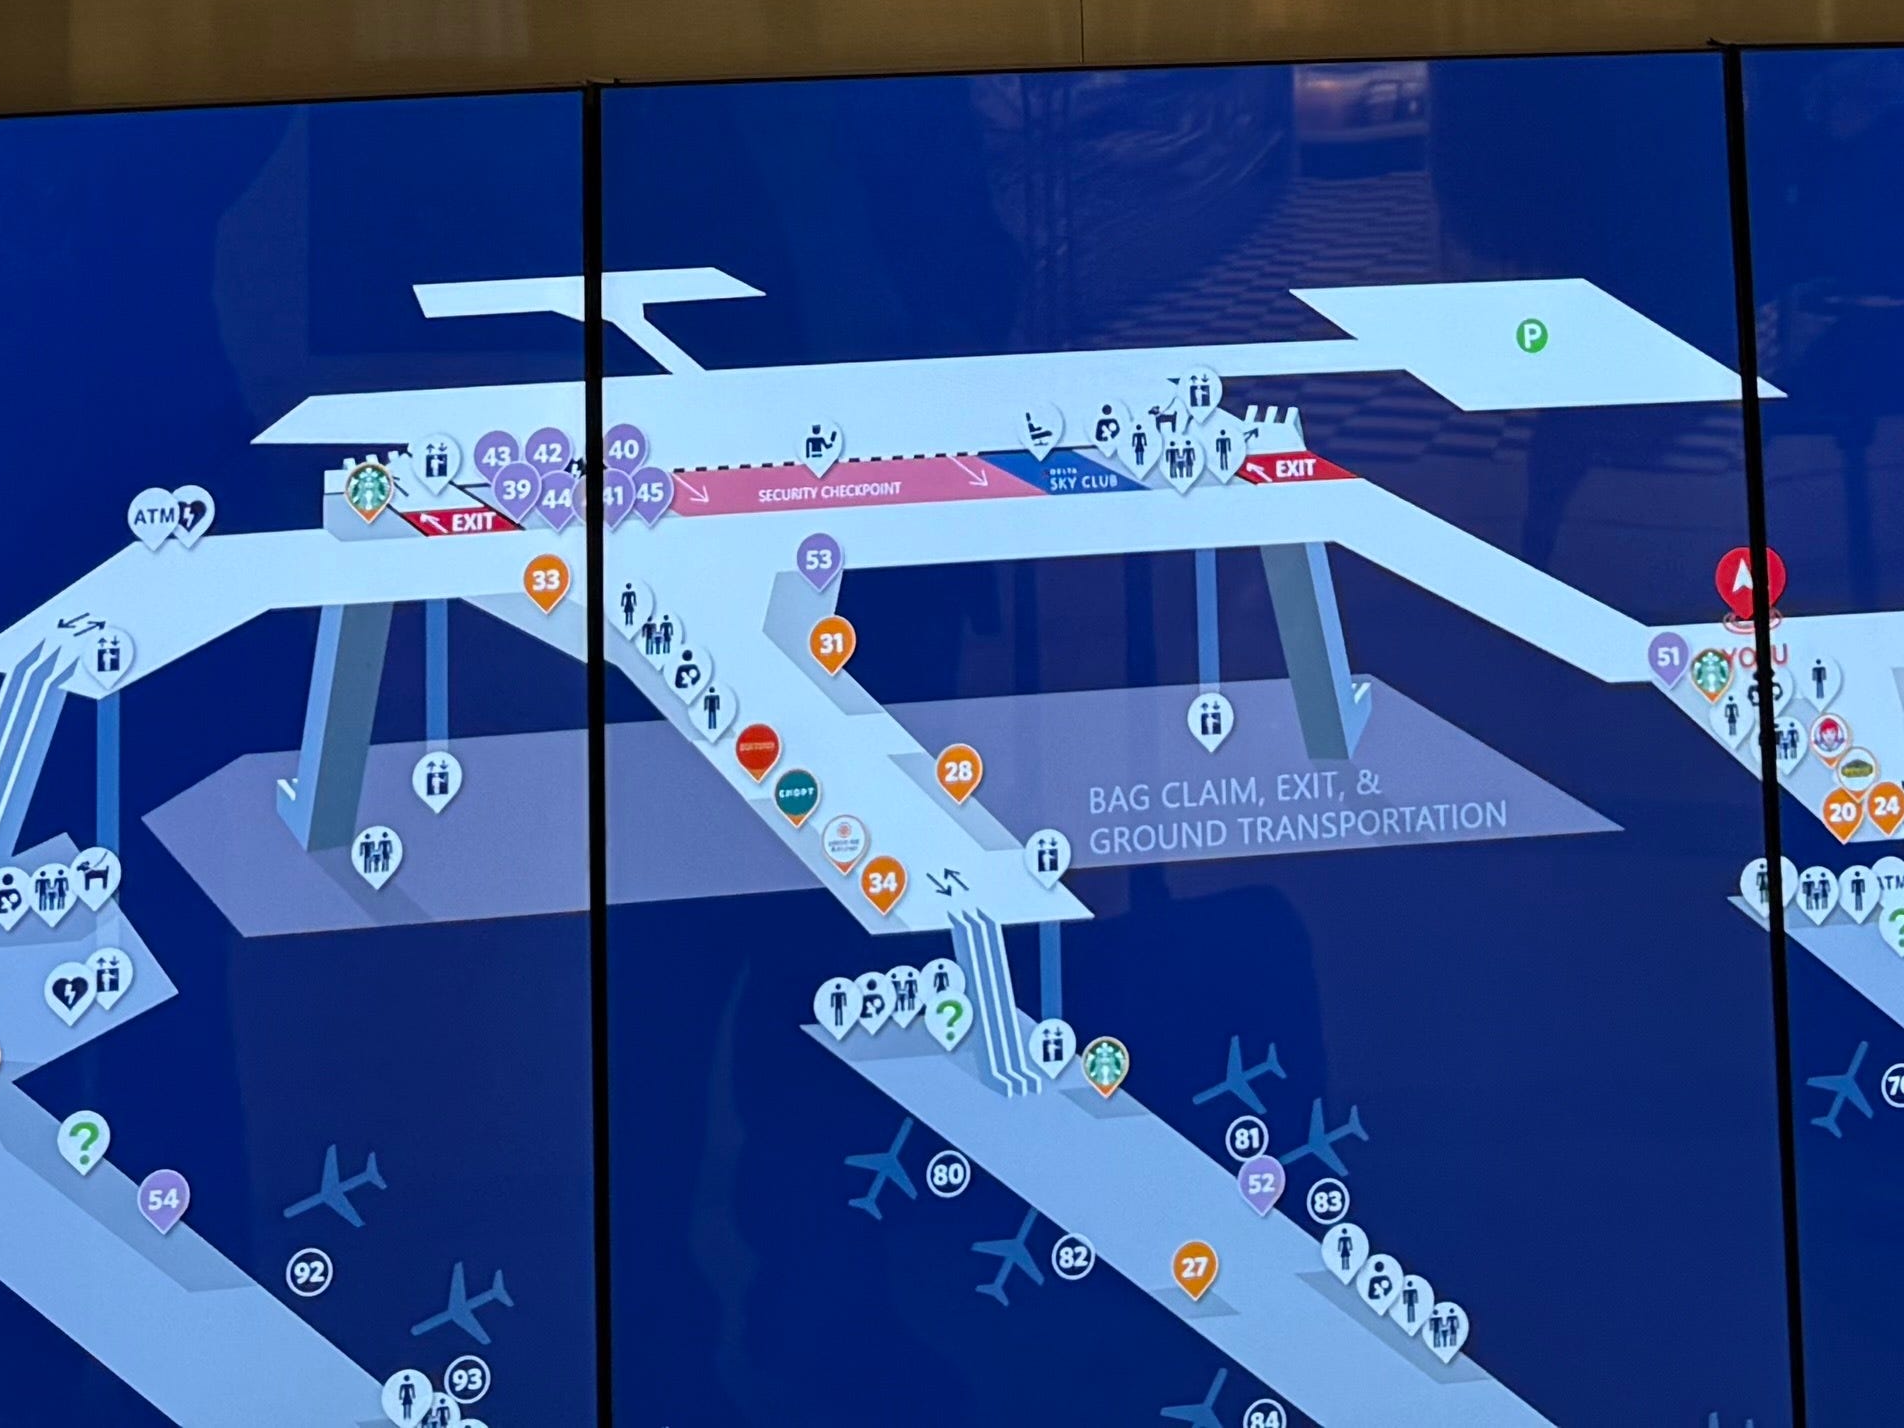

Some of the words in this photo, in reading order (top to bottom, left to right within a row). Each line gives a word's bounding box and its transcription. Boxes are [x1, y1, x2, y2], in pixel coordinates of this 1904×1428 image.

[1276, 459, 1316, 477] EXIT
[759, 487, 818, 502] SECURITY
[821, 482, 901, 498] CHECKPOINT
[1051, 477, 1076, 491] SKY
[1082, 475, 1117, 488] CLUB
[134, 507, 174, 525] ATM
[532, 569, 560, 592] 33
[1090, 784, 1149, 814] BAG
[1162, 777, 1265, 808] CLAIM,
[1278, 771, 1344, 802] EXIT,
[1357, 769, 1382, 794] &
[1090, 820, 1227, 854] GROUND
[1237, 800, 1508, 844] TRANSPORTATION
